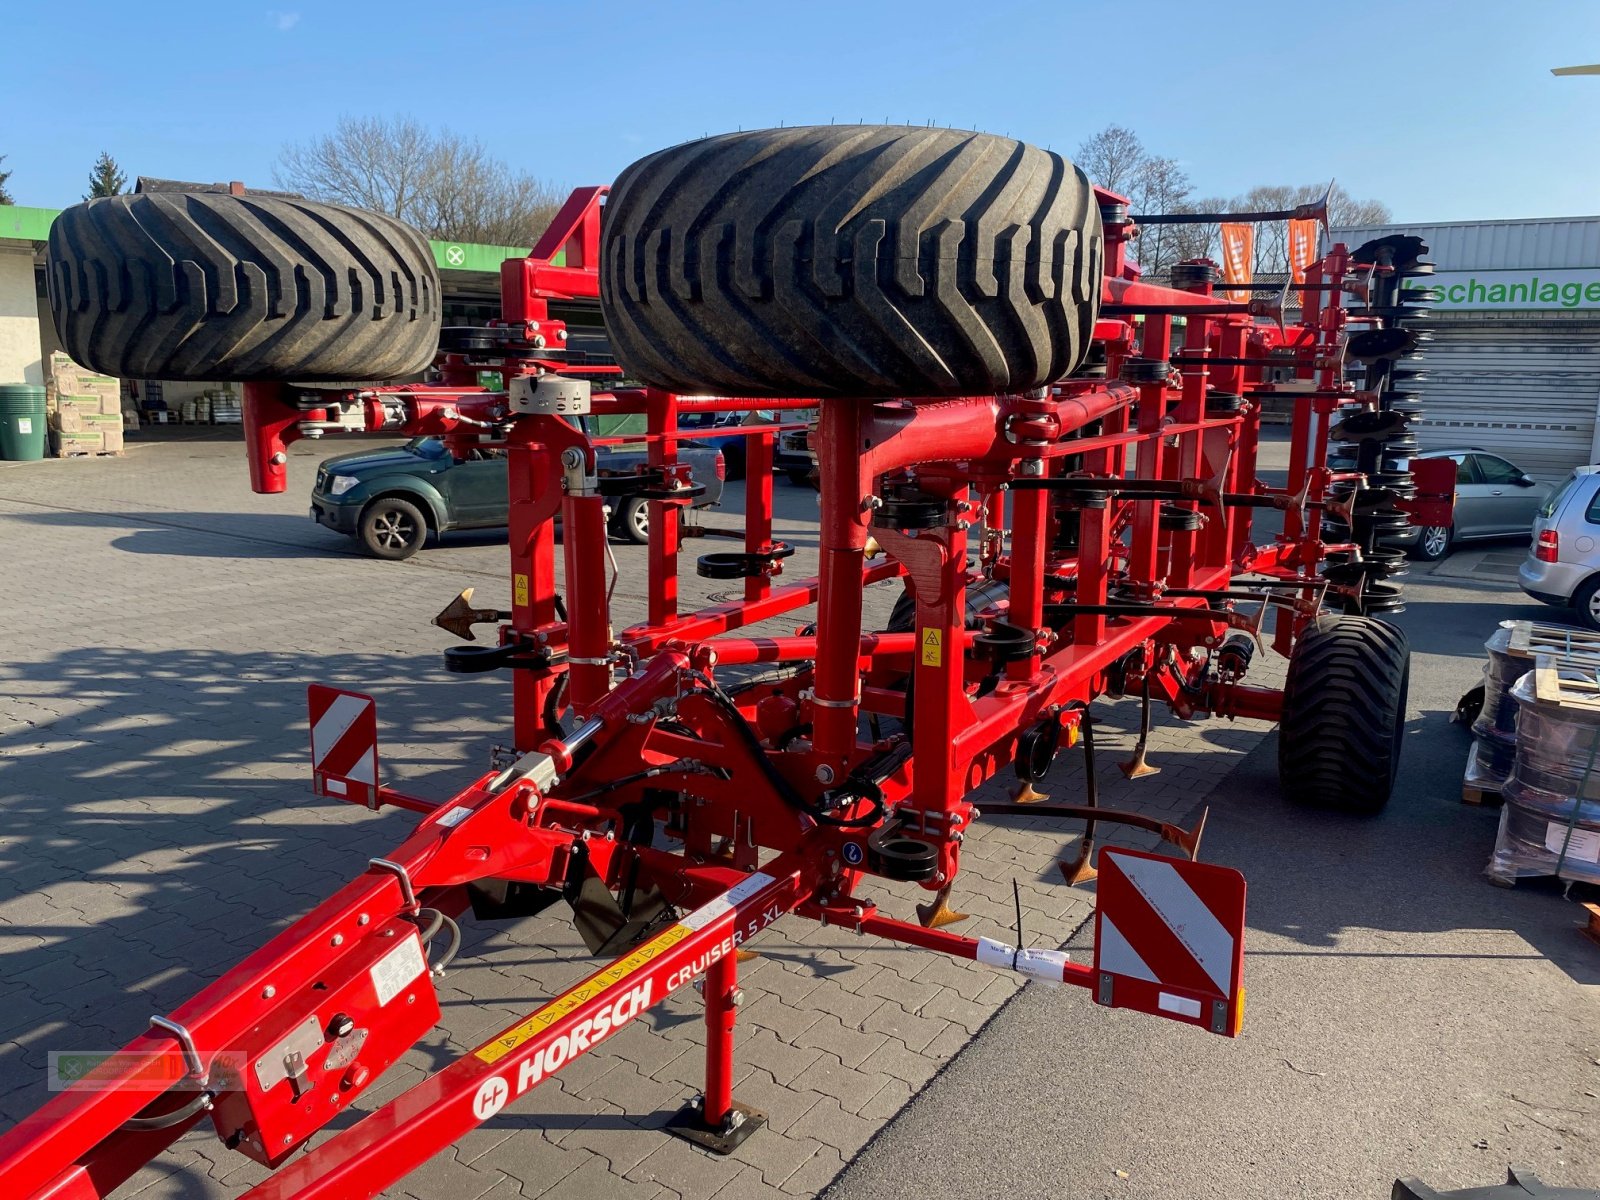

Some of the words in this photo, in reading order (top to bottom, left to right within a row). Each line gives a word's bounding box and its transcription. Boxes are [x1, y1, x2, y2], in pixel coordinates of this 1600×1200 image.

[1405, 278, 1600, 308] schanlage
[666, 929, 743, 991] CRUISER
[748, 919, 758, 937] 5
[762, 905, 784, 926] XL
[517, 977, 653, 1095] HORSCH
